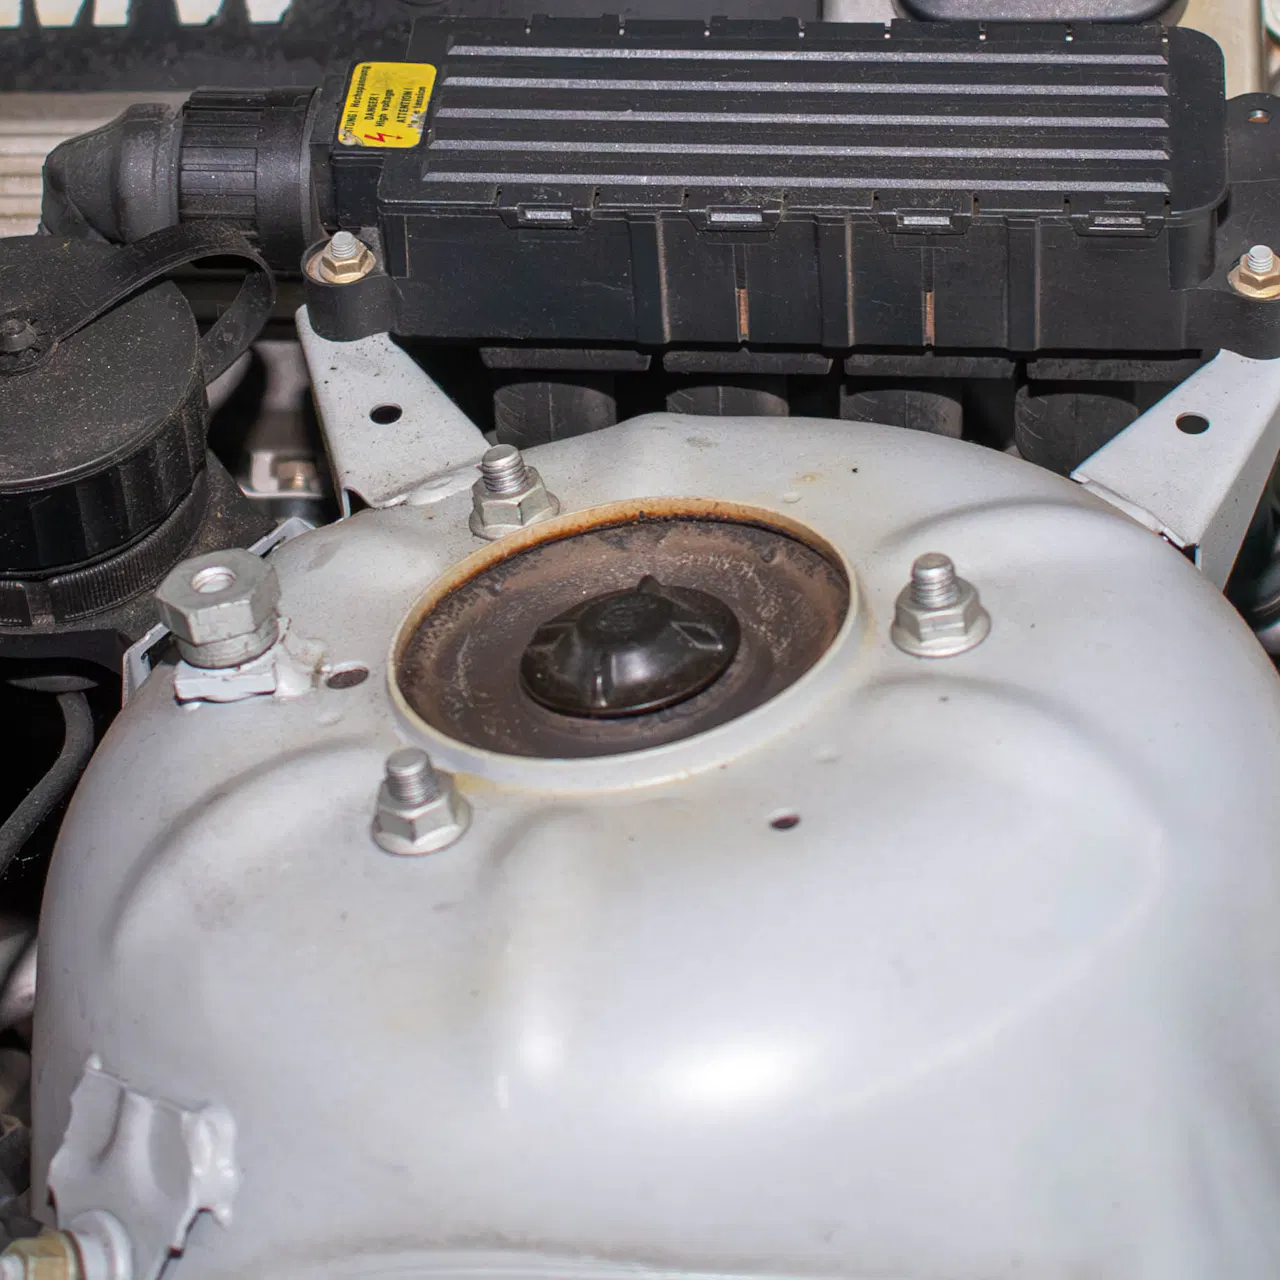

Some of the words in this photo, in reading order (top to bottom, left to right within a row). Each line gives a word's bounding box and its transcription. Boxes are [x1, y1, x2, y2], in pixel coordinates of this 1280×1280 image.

[350, 66, 372, 108] Hochspannung
[413, 86, 426, 108] tension
[381, 89, 395, 111] voltage
[375, 113, 389, 127] High
